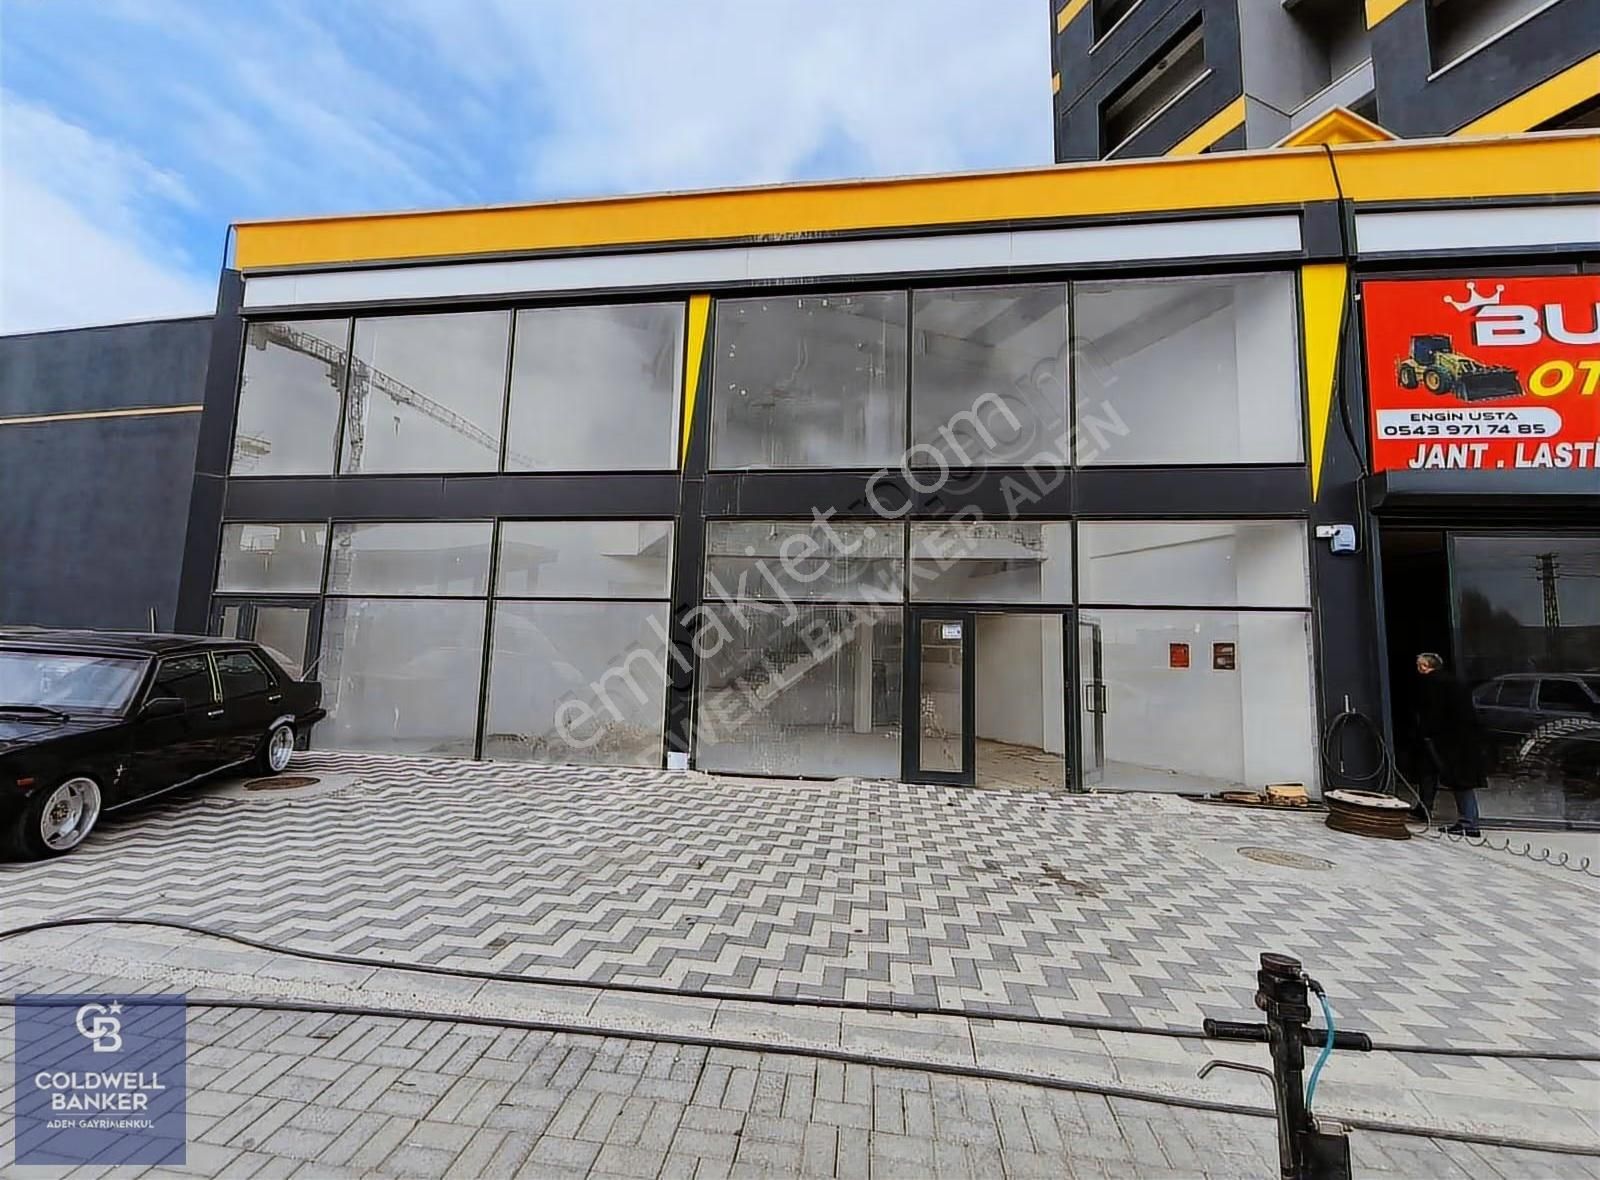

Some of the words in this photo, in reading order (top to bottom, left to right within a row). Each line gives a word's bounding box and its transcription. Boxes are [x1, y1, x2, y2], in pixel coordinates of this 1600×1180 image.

[1469, 412, 1518, 421] USTA
[1384, 426, 1440, 436] 0543
[1446, 426, 1480, 436] 971
[1487, 425, 1510, 435] 74
[1518, 425, 1546, 435] 85
[1409, 443, 1488, 469] JANT
